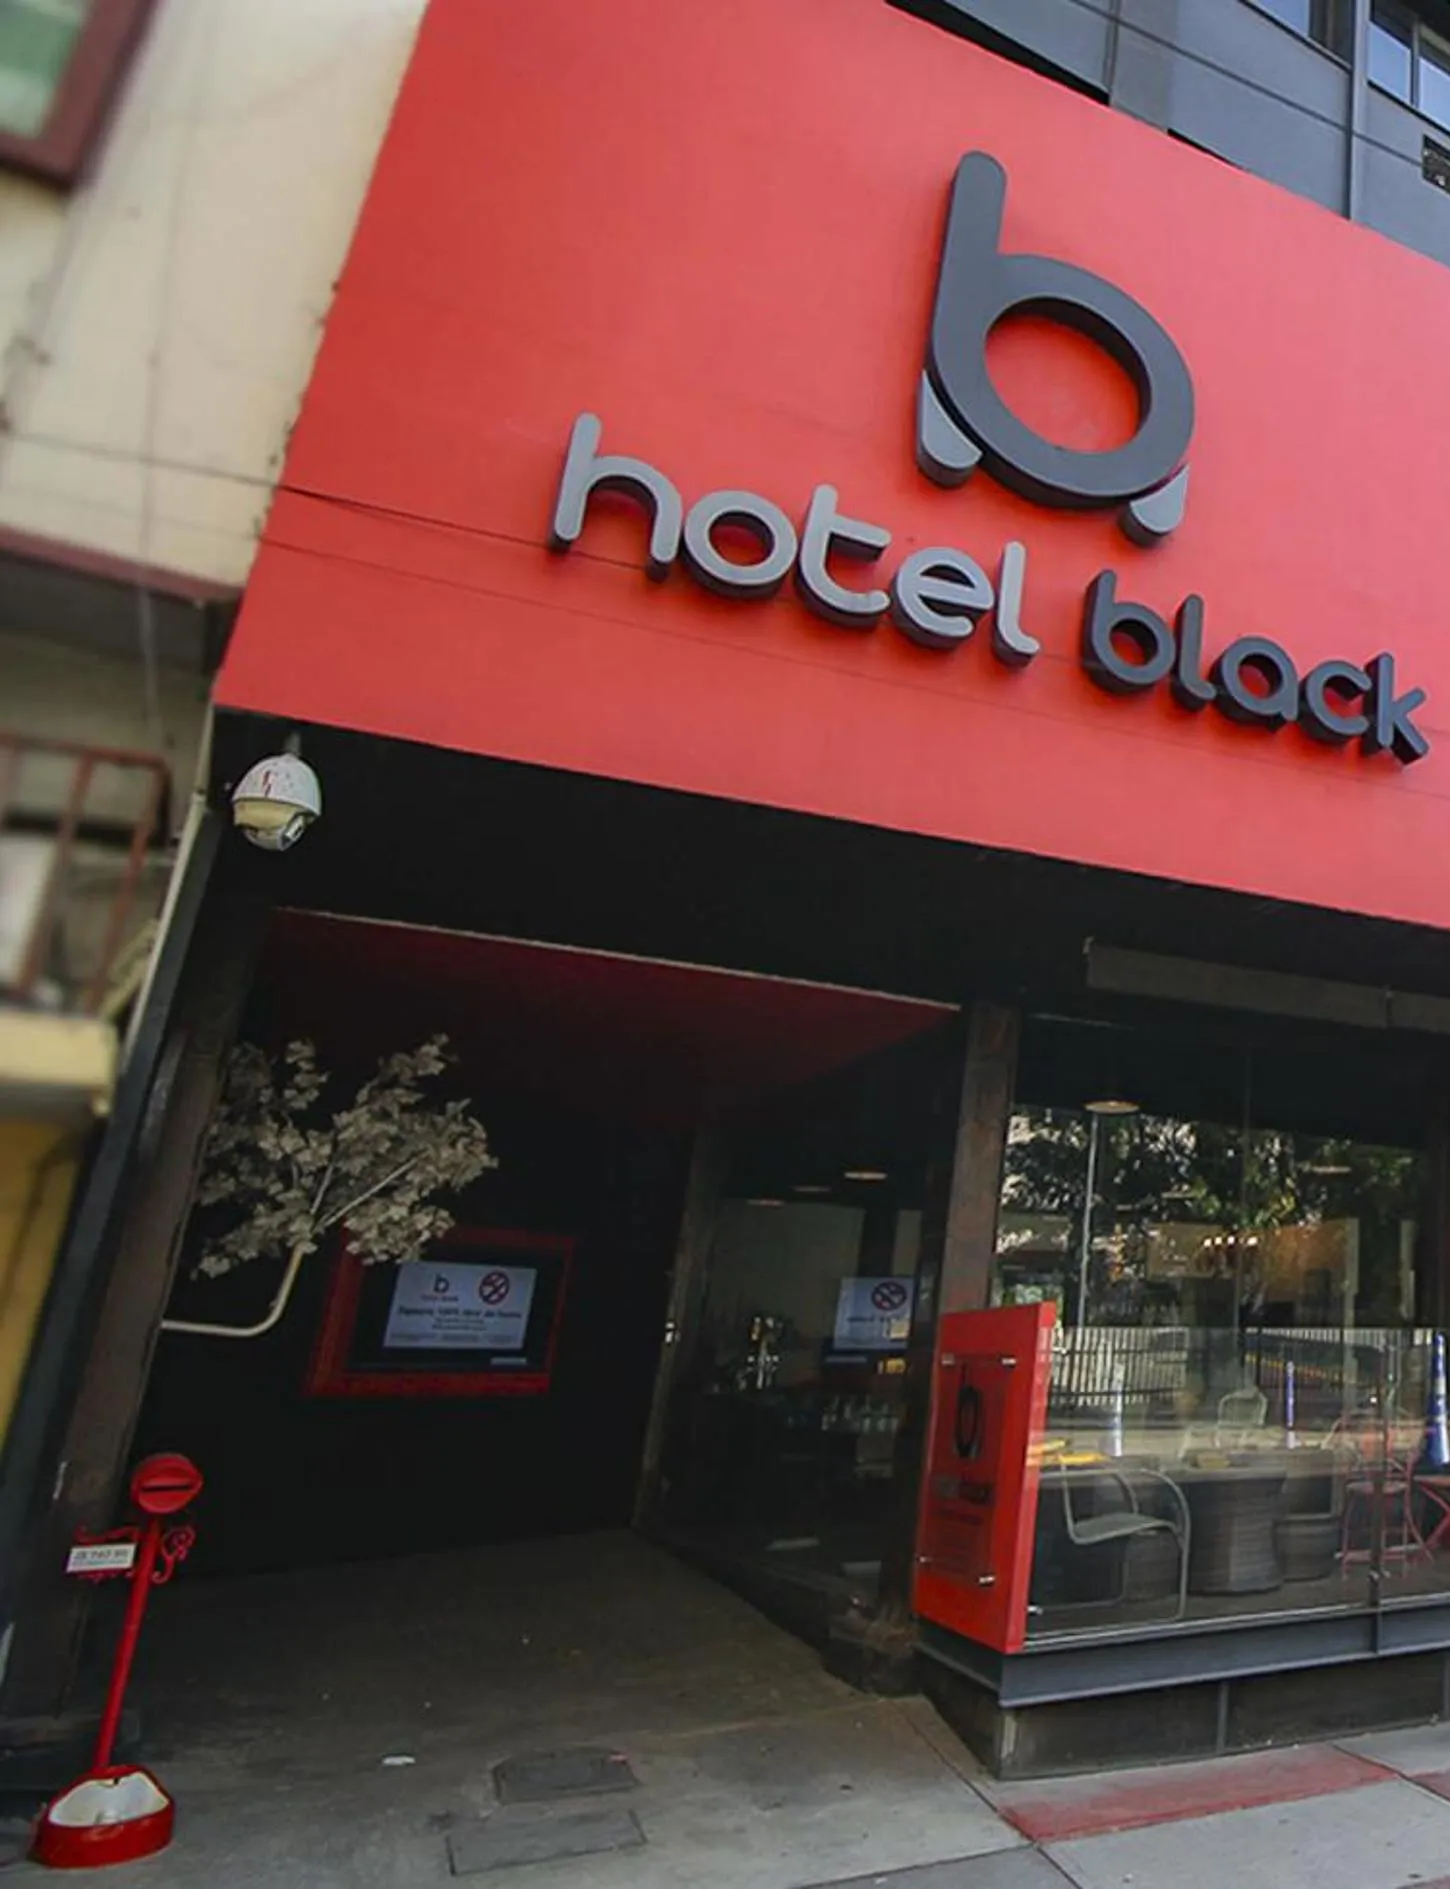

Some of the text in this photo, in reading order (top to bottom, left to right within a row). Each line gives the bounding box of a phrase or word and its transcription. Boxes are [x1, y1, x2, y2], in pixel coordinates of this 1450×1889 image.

[918, 151, 1194, 547] b
[549, 413, 1429, 764] hotel black
[433, 1274, 449, 1293] b
